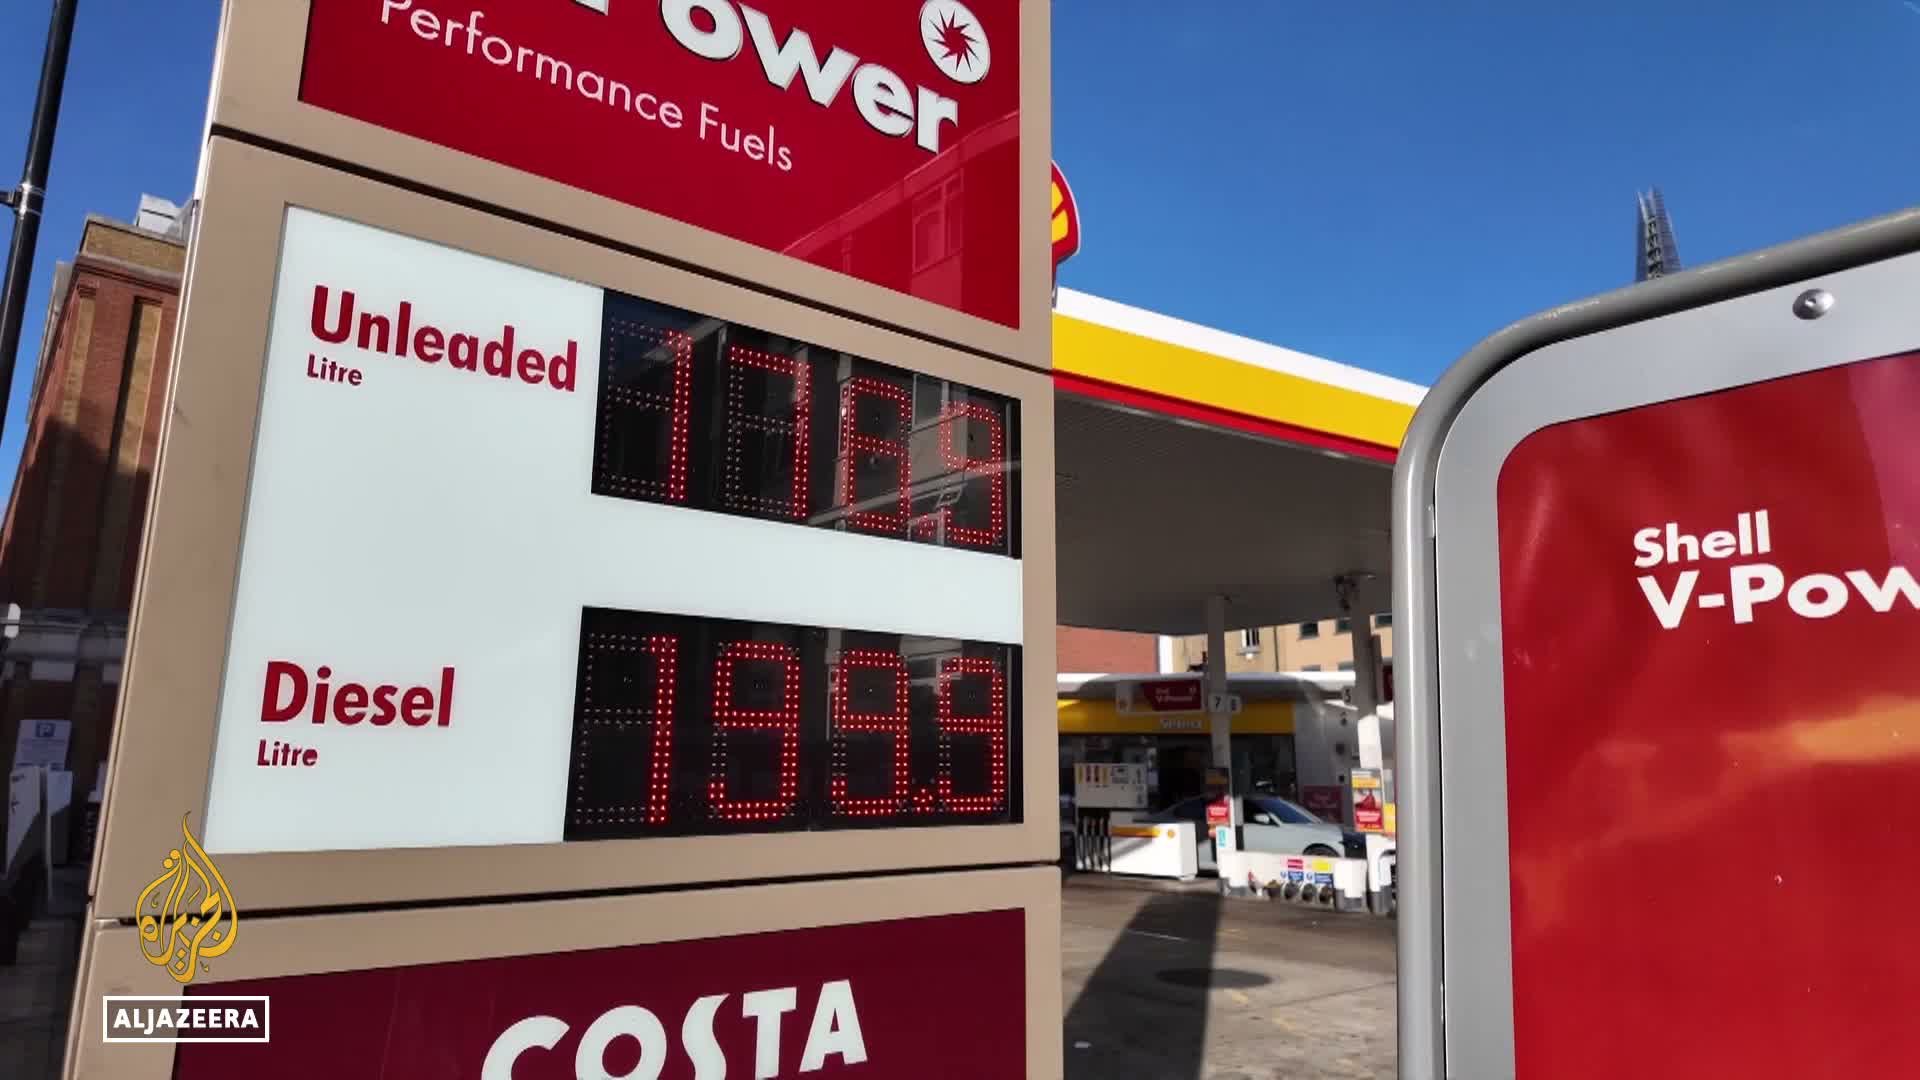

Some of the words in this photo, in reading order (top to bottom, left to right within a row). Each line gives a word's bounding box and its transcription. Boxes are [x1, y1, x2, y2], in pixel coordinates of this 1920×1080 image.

[381, 0, 683, 129] Performance
[700, 102, 793, 171] Fuels
[577, 0, 958, 154] ower
[307, 354, 363, 386] Litre
[310, 285, 577, 392] Unleaded
[1633, 509, 1771, 568] Shell
[261, 661, 455, 727] Diesel
[648, 636, 1004, 823] 199.9
[257, 739, 318, 766] Litre
[481, 979, 868, 1080] COSTA
